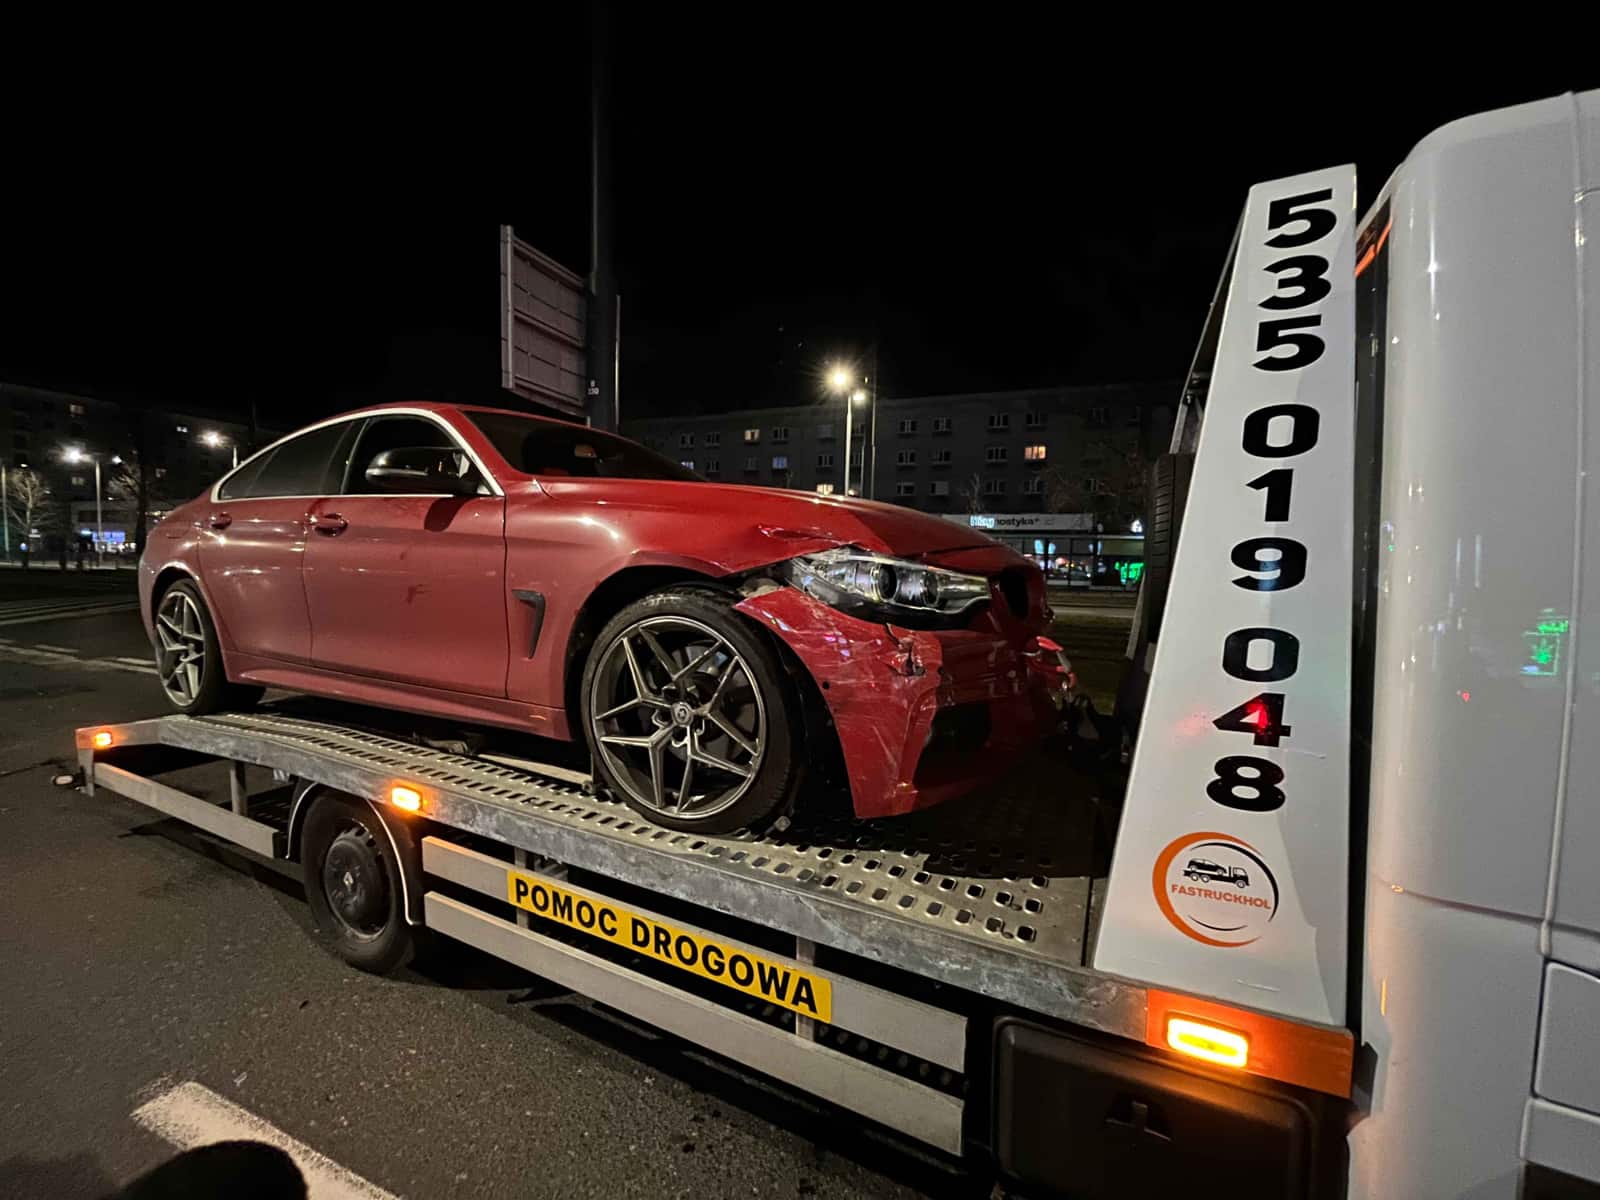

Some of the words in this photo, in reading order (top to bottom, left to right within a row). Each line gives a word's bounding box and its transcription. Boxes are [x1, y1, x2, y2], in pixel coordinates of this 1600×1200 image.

[1252, 188, 1337, 373] 535
[1229, 403, 1321, 592] 019
[1206, 627, 1300, 812] 048
[515, 878, 618, 937] POMOC
[631, 918, 818, 1014] DROGOWA
[1171, 884, 1272, 910] FASTRUCKHOL
